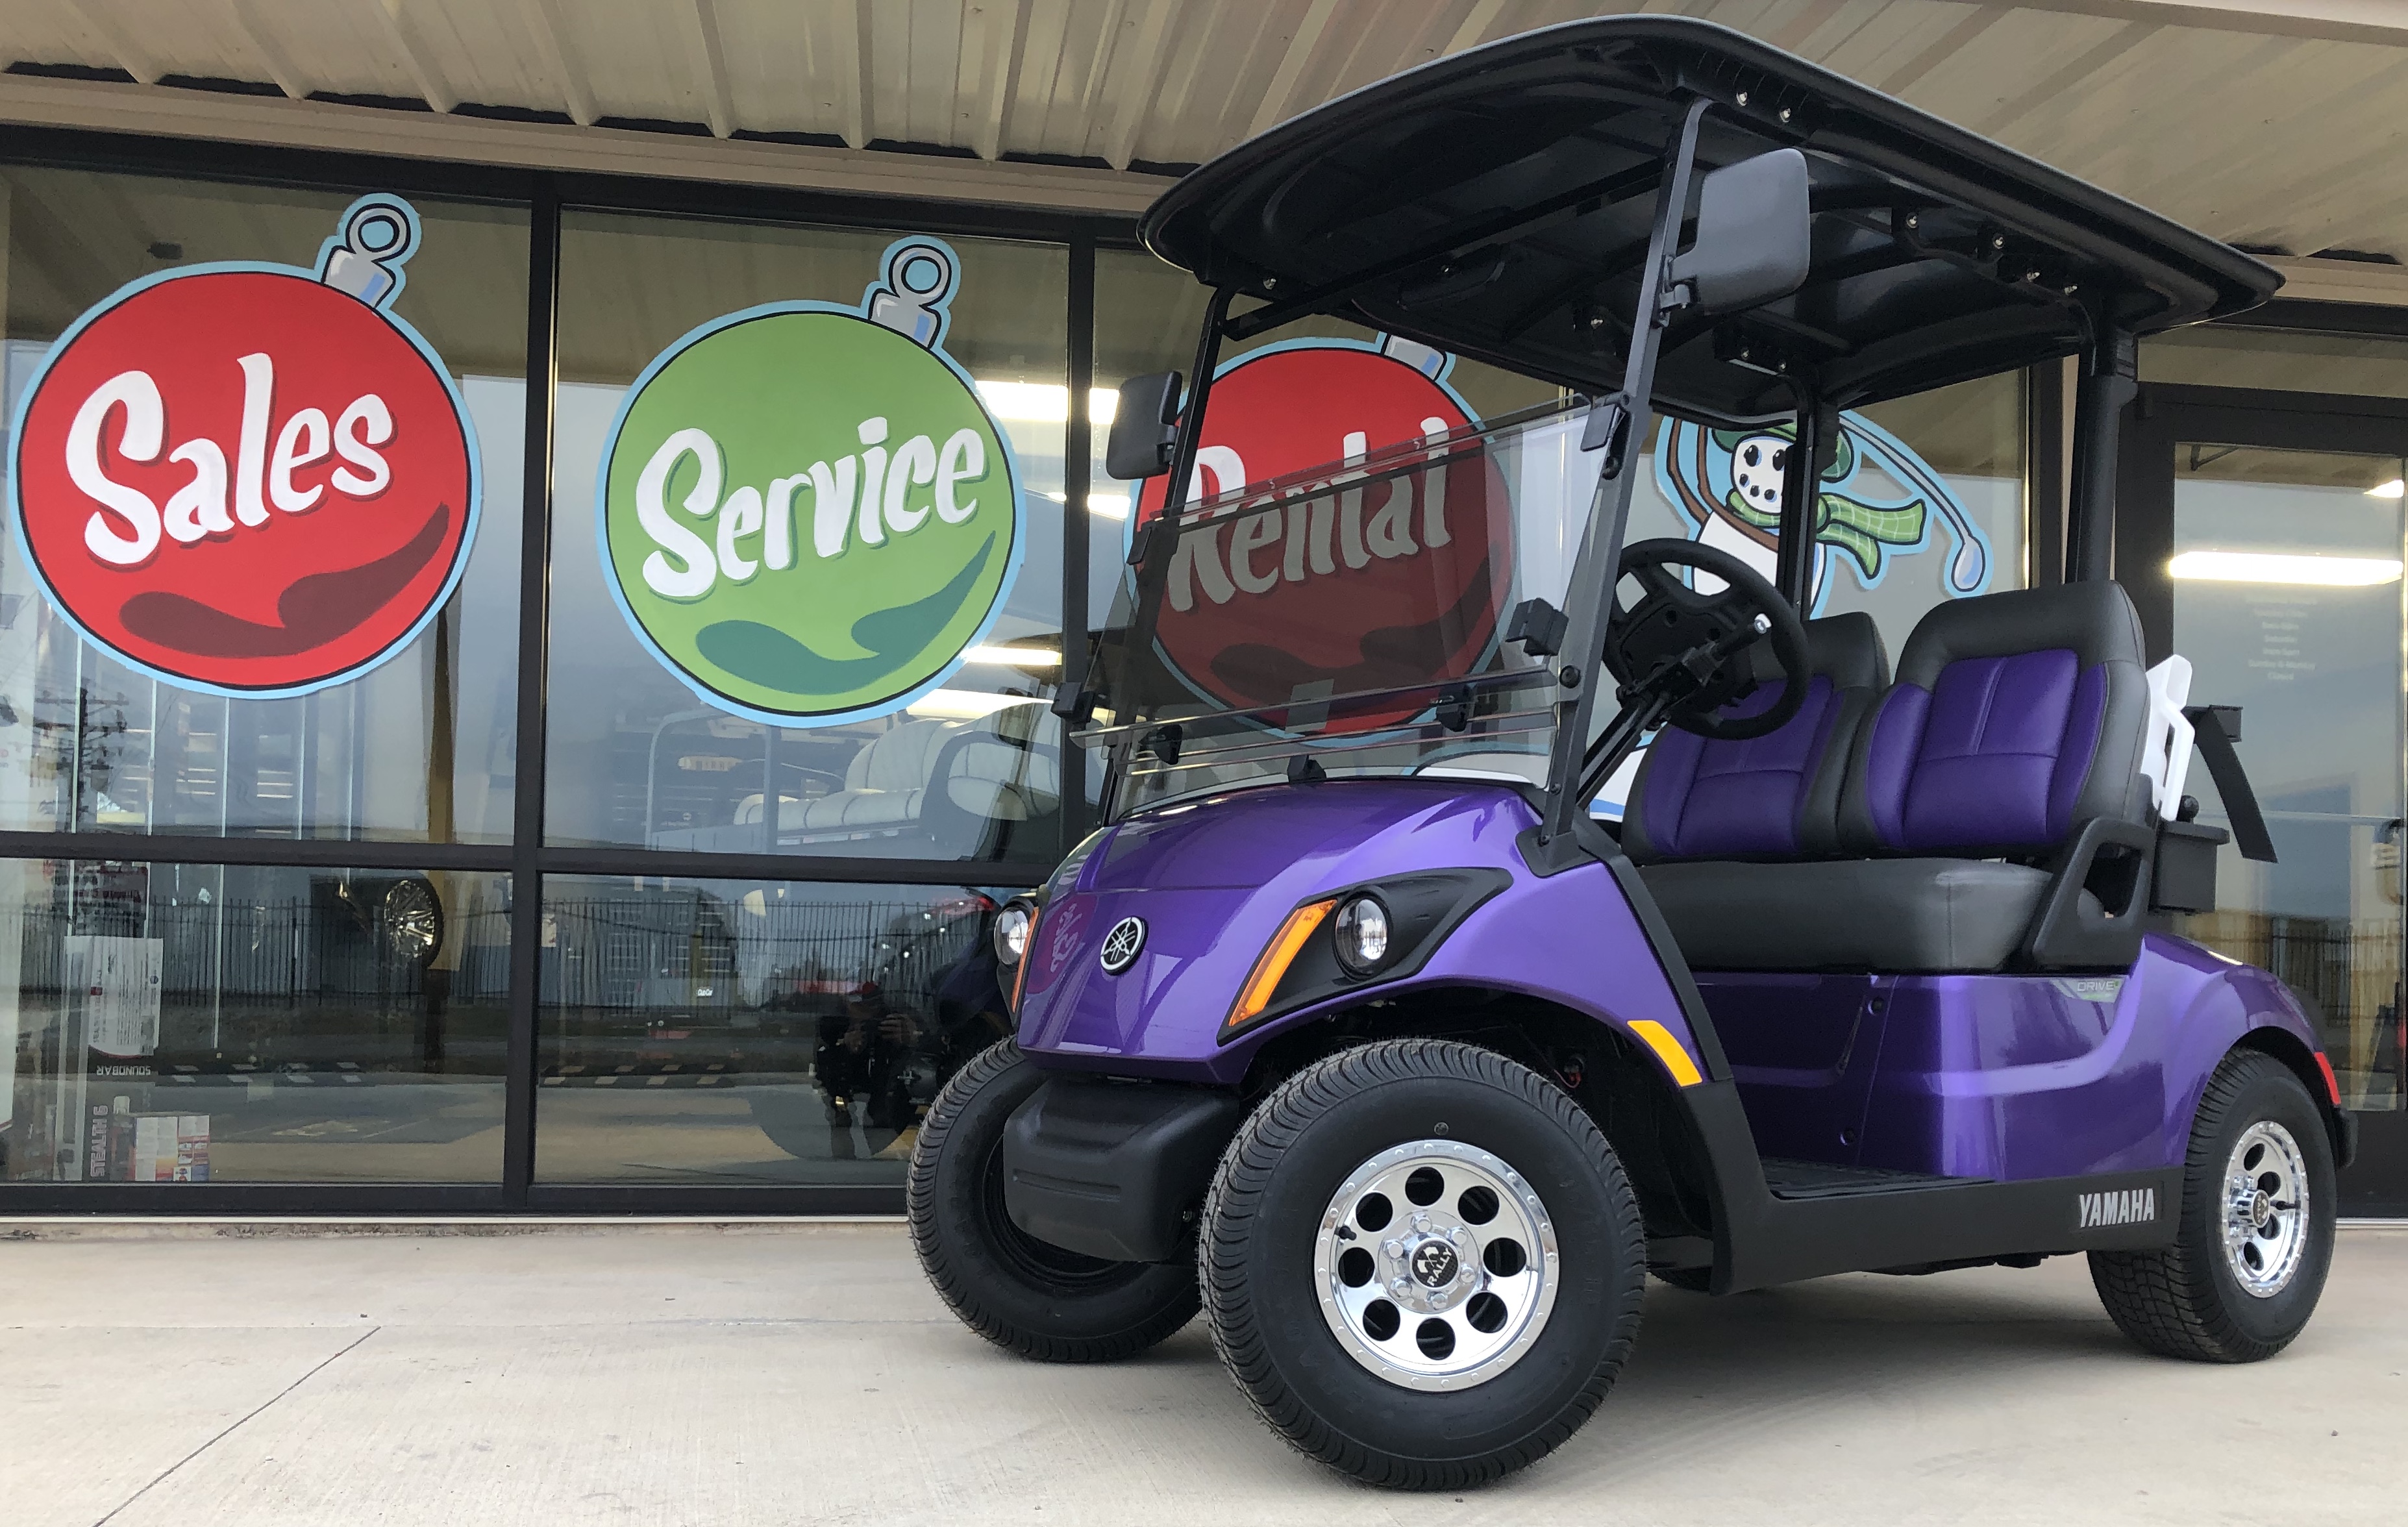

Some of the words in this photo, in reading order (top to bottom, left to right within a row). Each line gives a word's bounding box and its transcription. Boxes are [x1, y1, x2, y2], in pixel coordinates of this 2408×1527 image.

[66, 353, 394, 565] Sales
[636, 417, 985, 597] Service
[1168, 417, 1451, 612] Rental
[95, 1065, 151, 1076] SOUNDBAR
[90, 1118, 107, 1177] STEALTH
[2079, 1188, 2154, 1228] YAMAHA
[1427, 1247, 1452, 1287] RALLY
